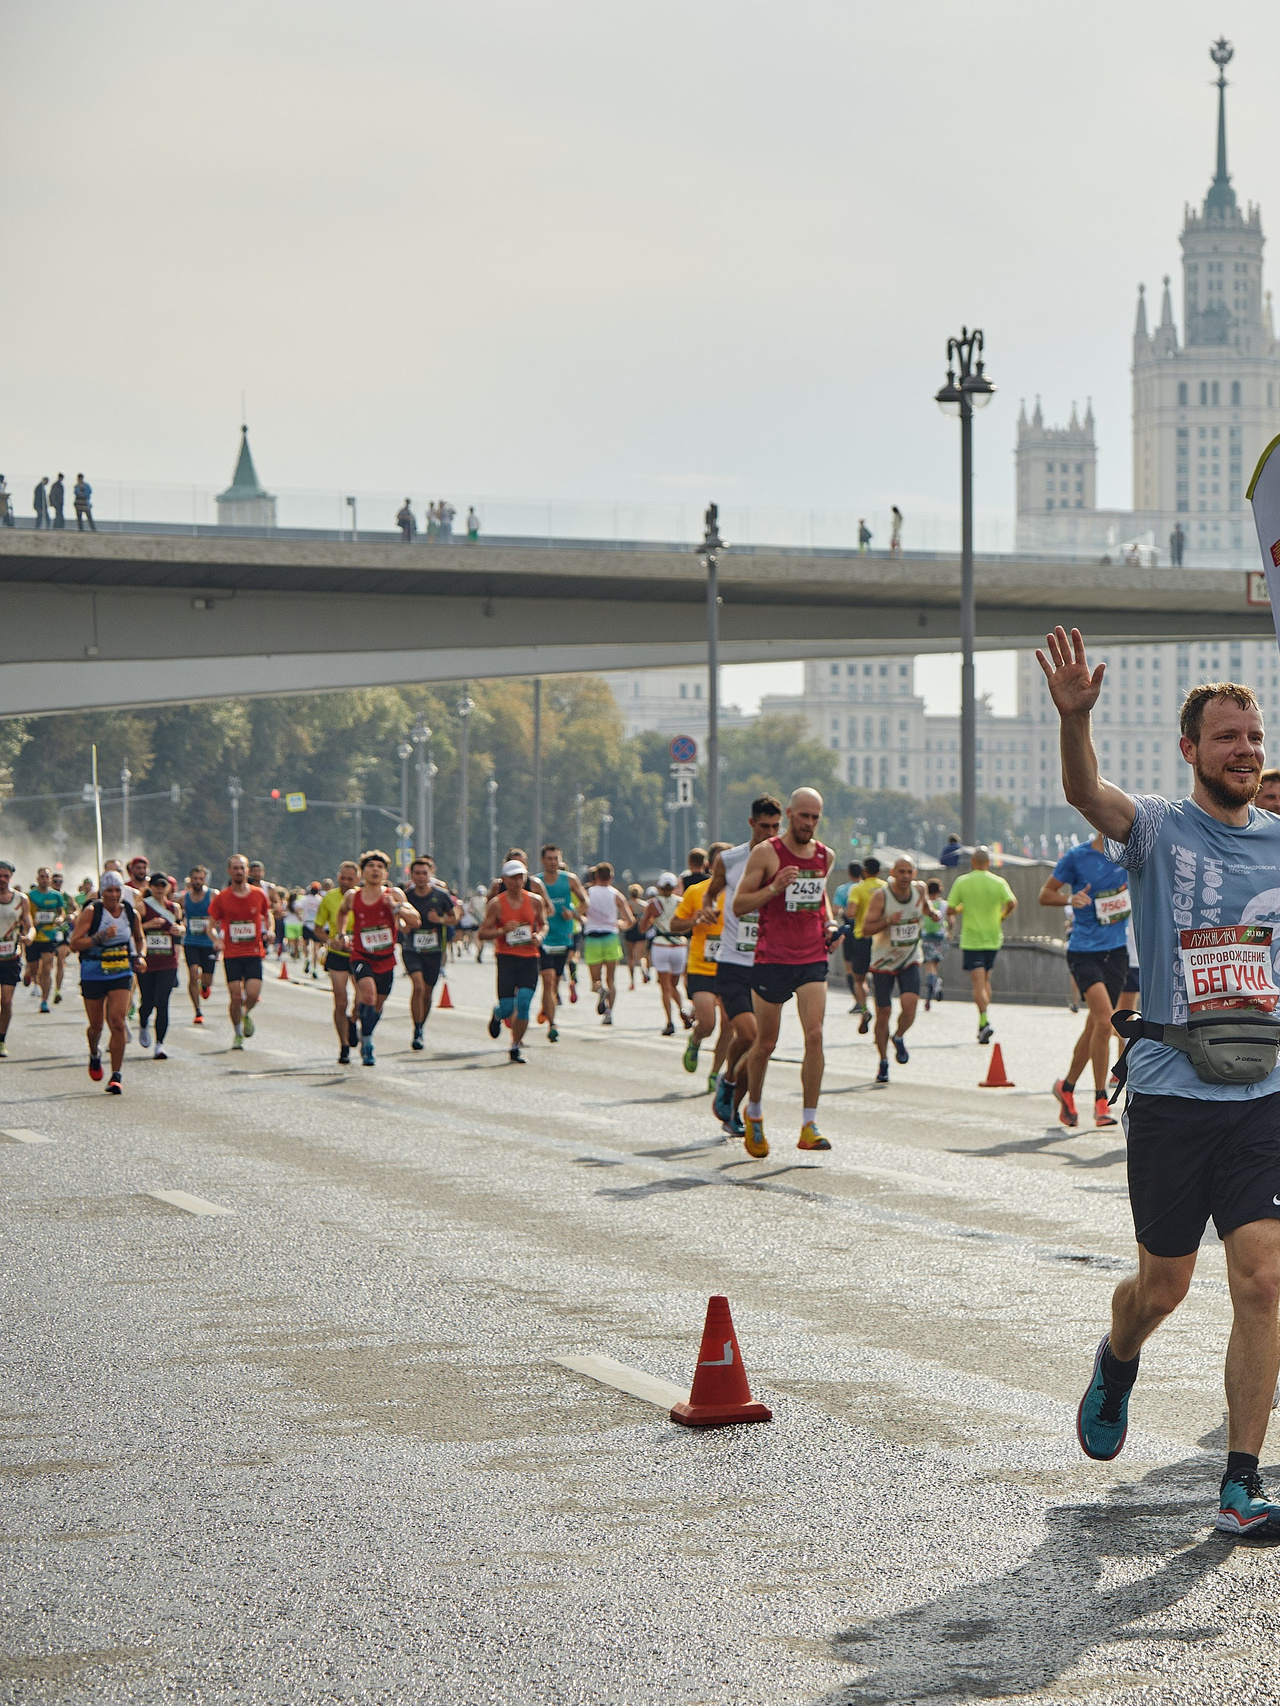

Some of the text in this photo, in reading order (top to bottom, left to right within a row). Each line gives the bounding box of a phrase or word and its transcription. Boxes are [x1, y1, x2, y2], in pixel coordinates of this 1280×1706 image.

[1190, 930, 1237, 948] ЛУЖНИКИ
[1190, 949, 1266, 966] СОПРОВОЖДЕНИЕ
[1192, 964, 1275, 997] БЕГУНА
